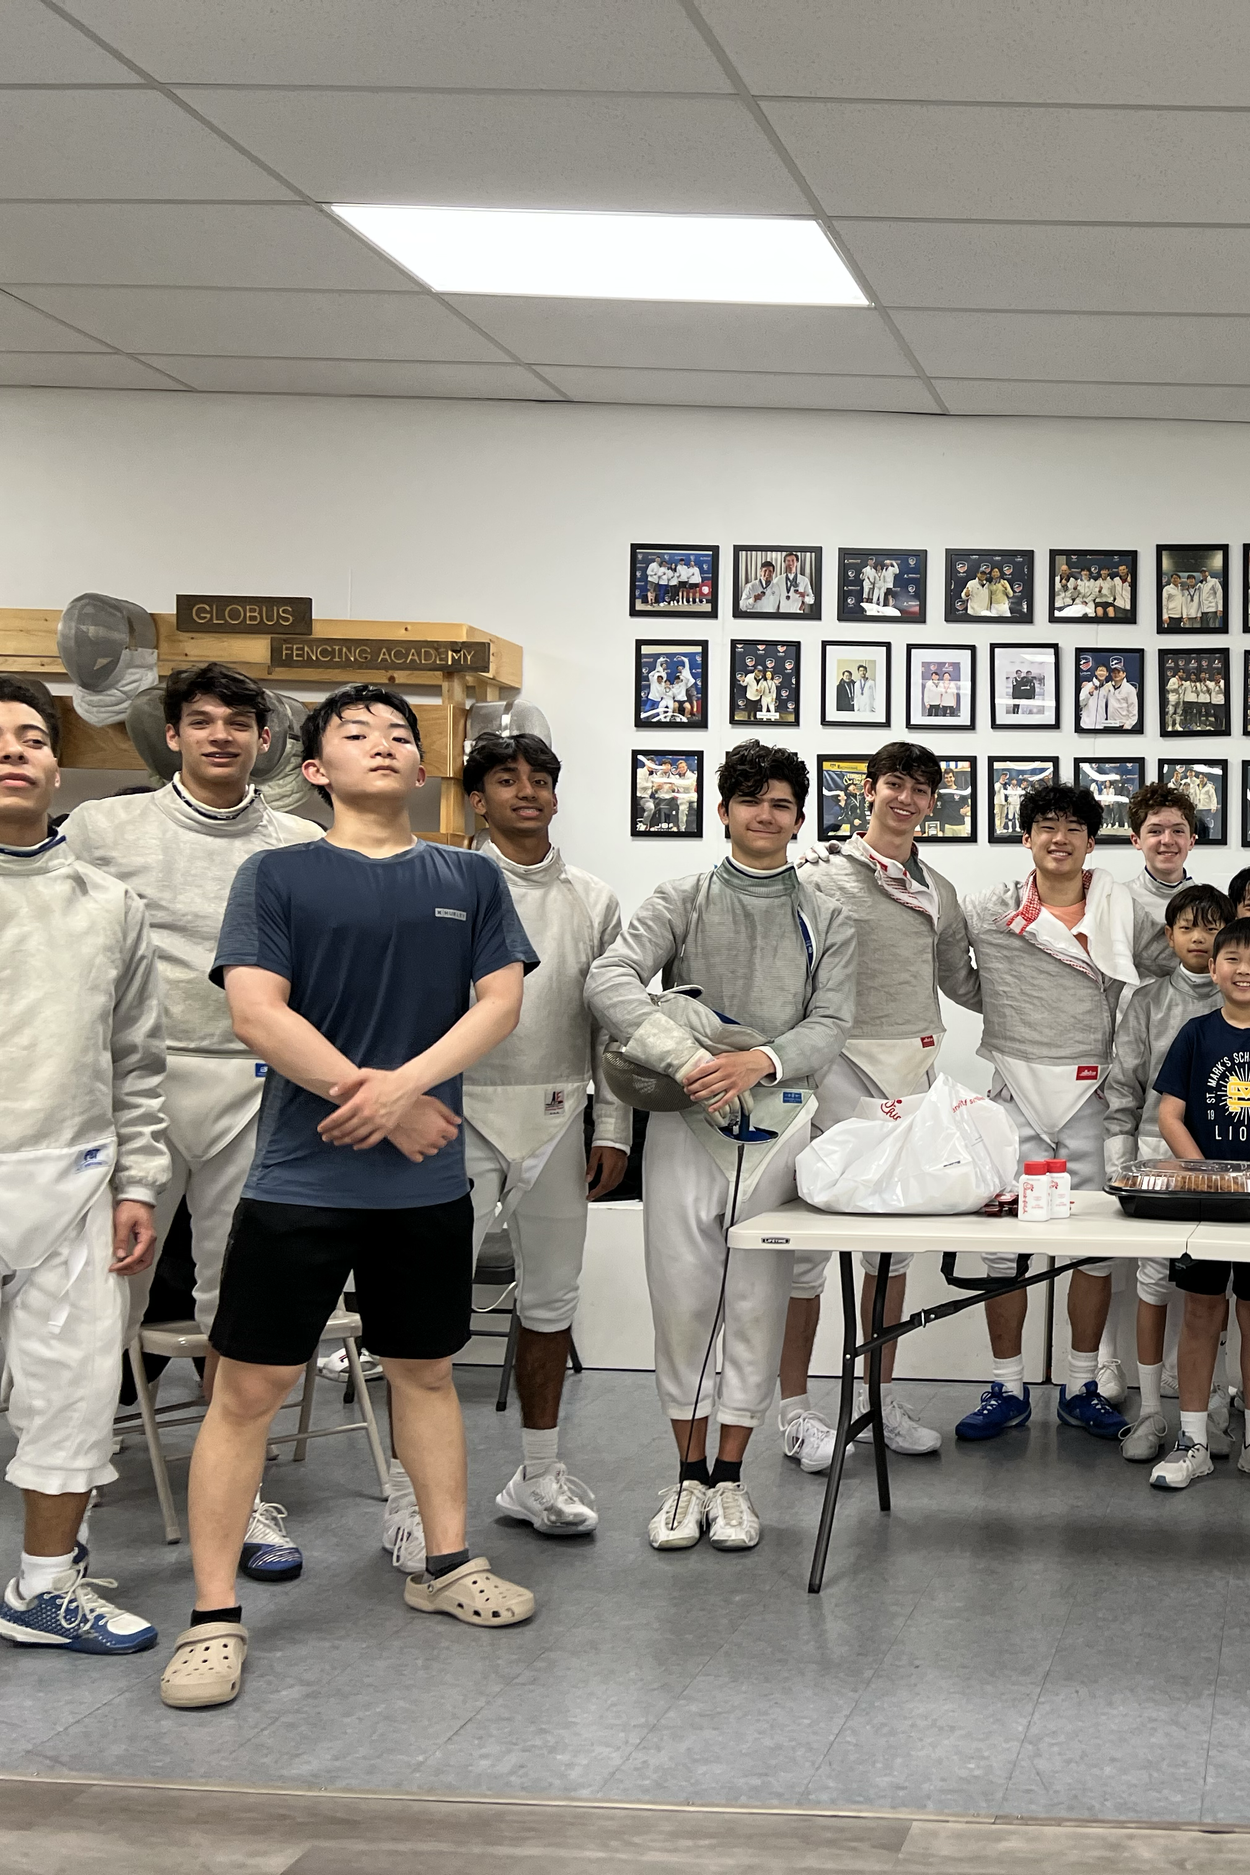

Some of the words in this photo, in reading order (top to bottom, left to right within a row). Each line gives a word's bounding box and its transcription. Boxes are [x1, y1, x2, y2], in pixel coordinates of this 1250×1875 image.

[192, 604, 293, 625] GLOBUS
[282, 644, 371, 662] FENCING
[378, 647, 475, 665] ACADEMY
[1207, 1056, 1231, 1088] MARK'S
[1206, 1091, 1216, 1104] ST.
[1207, 1109, 1215, 1120] 19
